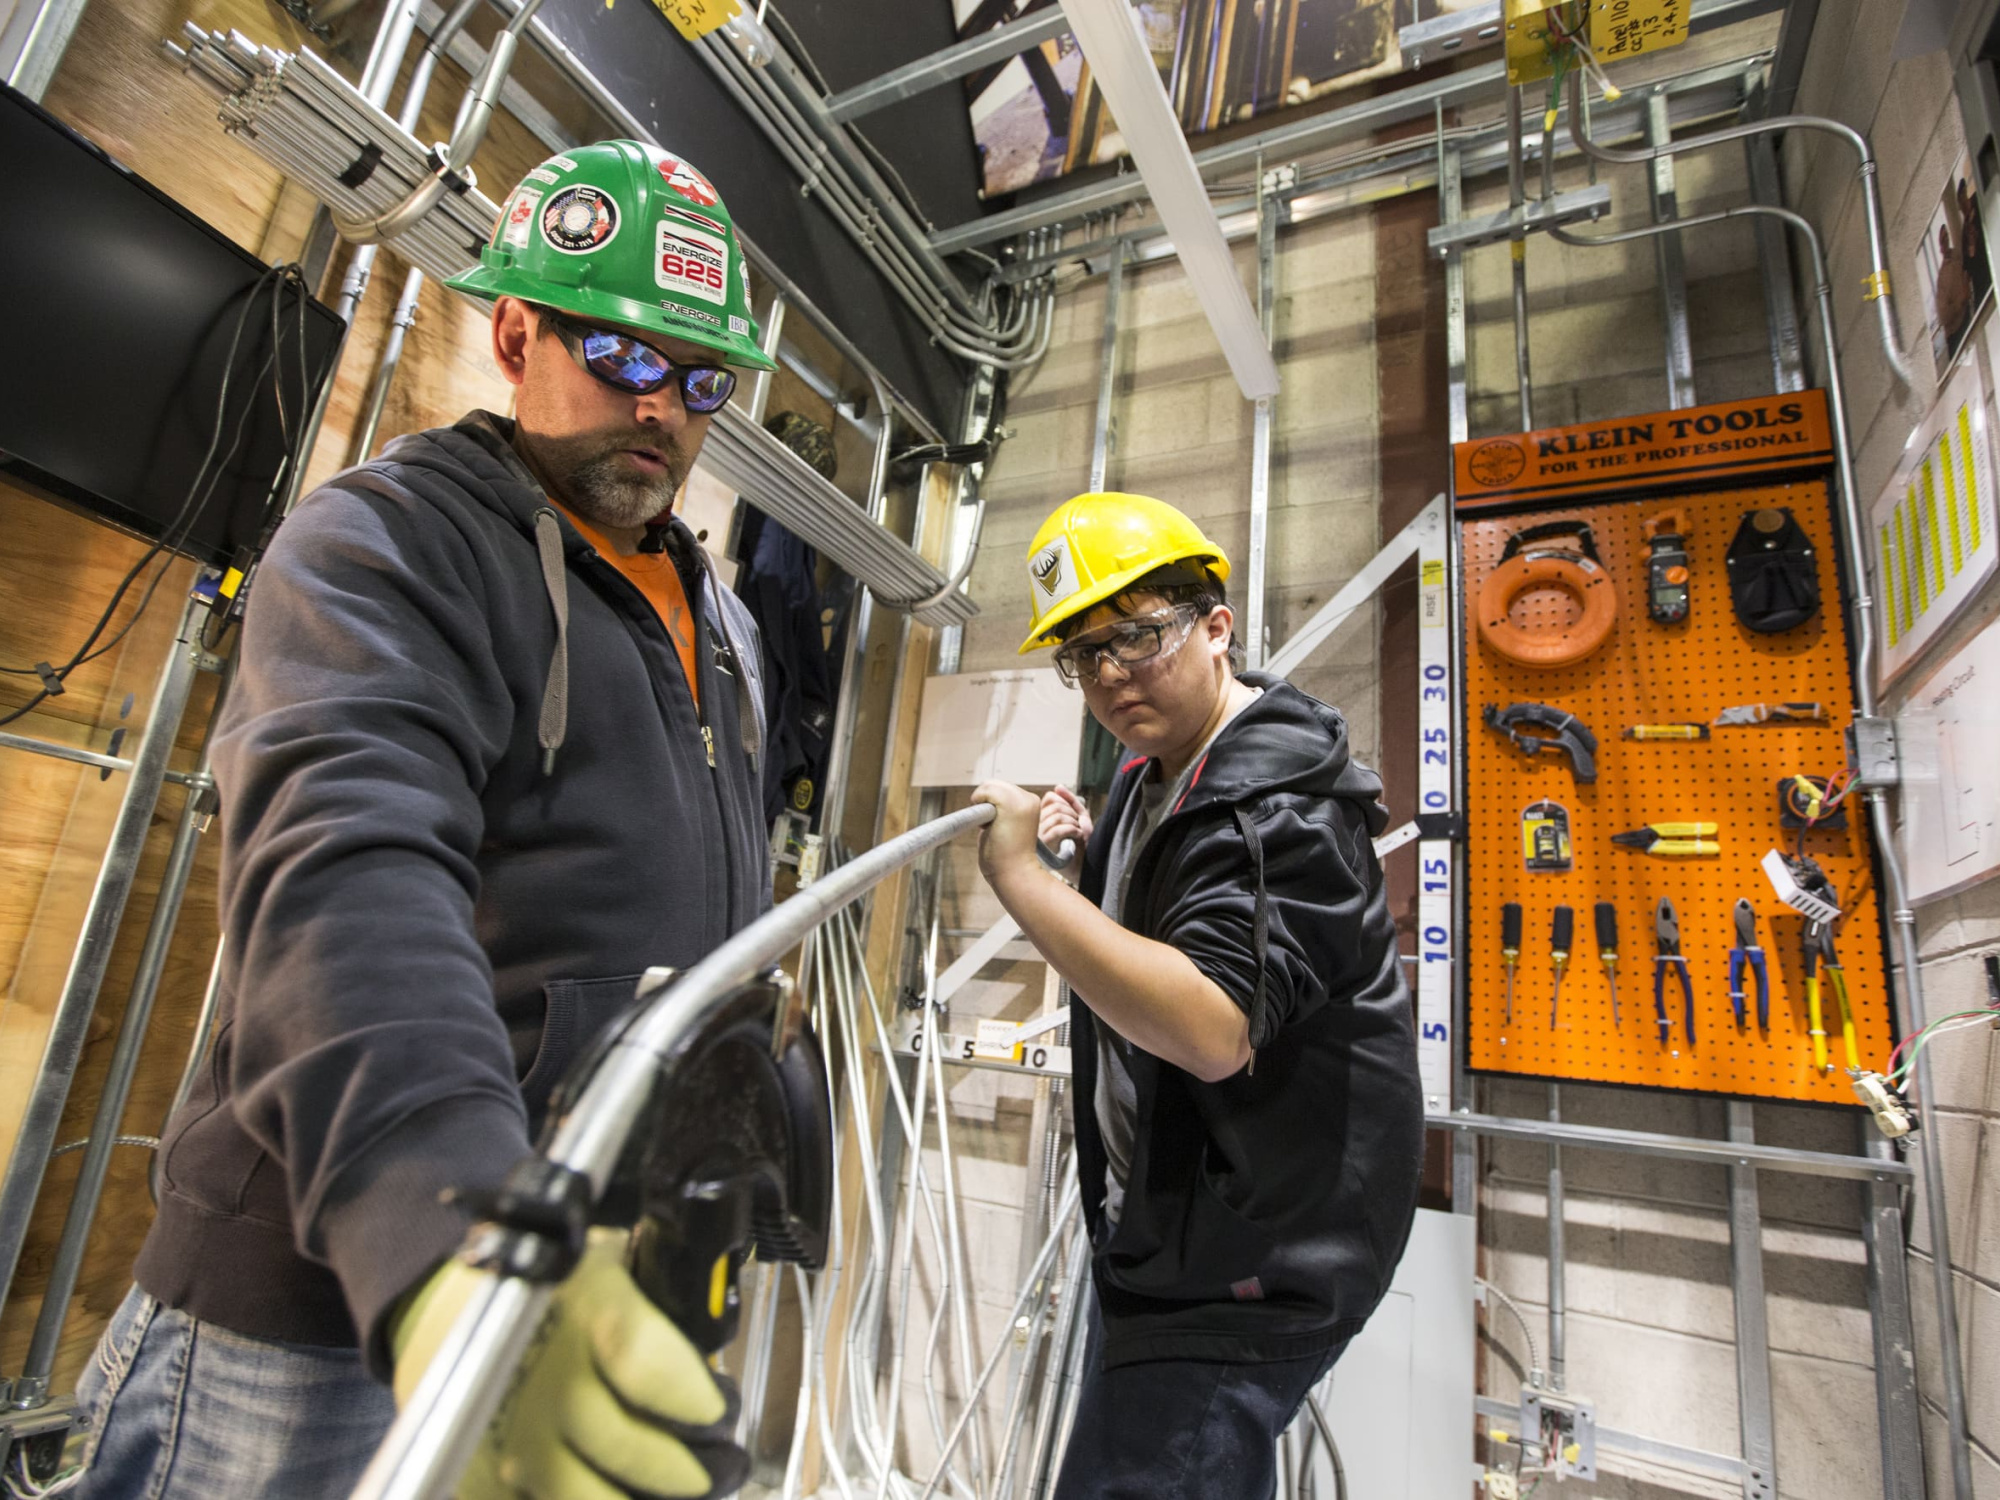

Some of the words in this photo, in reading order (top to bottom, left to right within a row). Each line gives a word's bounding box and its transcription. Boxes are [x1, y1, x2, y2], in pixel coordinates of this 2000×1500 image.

[1607, 24, 1628, 55] Panel
[663, 242, 722, 268] ENERGIZE
[662, 253, 723, 290] 625
[661, 301, 721, 326] ENERGIZE
[1538, 423, 1654, 458] KLEIN
[1668, 403, 1803, 439] TOOLS
[1539, 460, 1579, 476] FOR
[1586, 454, 1629, 470] THE
[1635, 431, 1809, 463] PROFESSIONAL
[1426, 594, 1436, 617] RISE
[1424, 665, 1446, 702] 30
[1424, 728, 1447, 766] 25
[1424, 859, 1448, 892] 15
[1424, 926, 1448, 963] 10
[1423, 1023, 1447, 1042] 5
[962, 1041, 975, 1060] 5
[1020, 1047, 1047, 1068] 10
